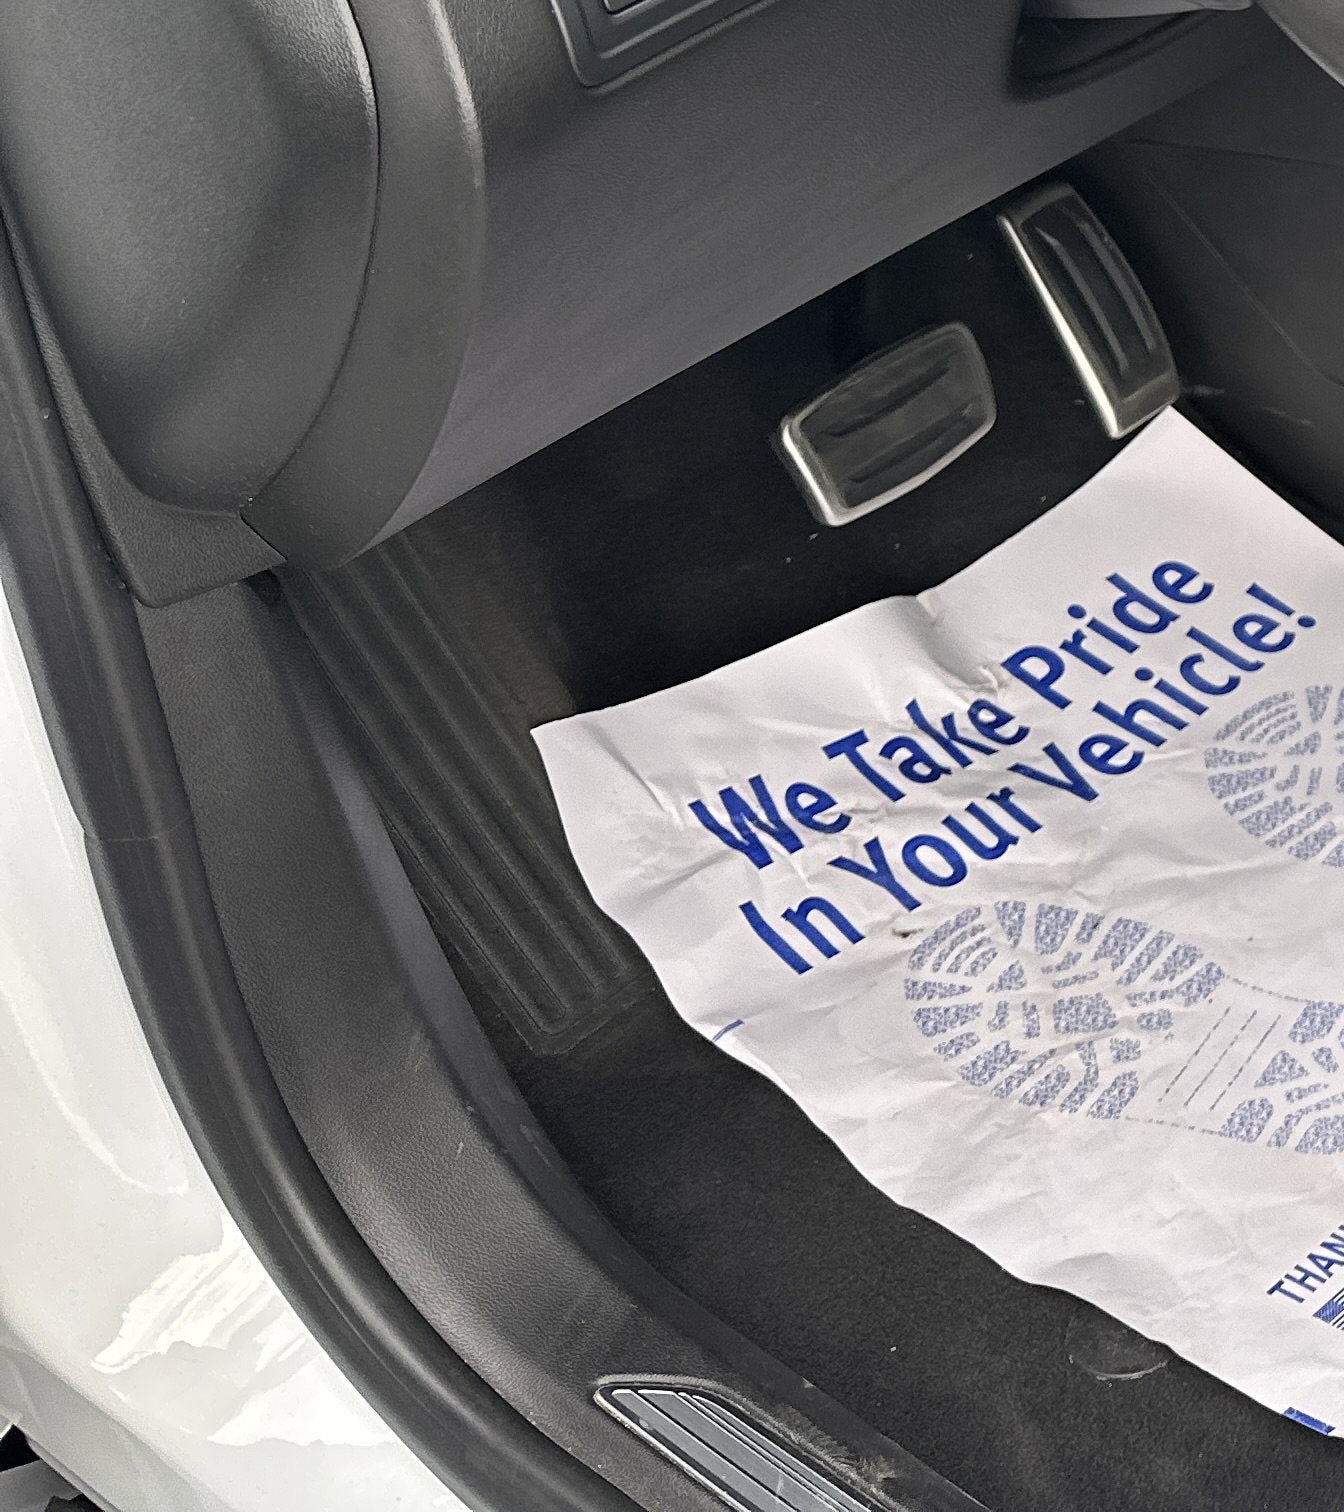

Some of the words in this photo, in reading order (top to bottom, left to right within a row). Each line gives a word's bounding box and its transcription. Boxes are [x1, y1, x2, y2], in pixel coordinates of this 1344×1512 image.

[689, 774, 852, 870] We
[822, 698, 1030, 805] Take
[1002, 559, 1215, 710] Pride
[737, 889, 866, 976] In
[828, 783, 1043, 912] Your
[1010, 581, 1318, 804] Vehicle!
